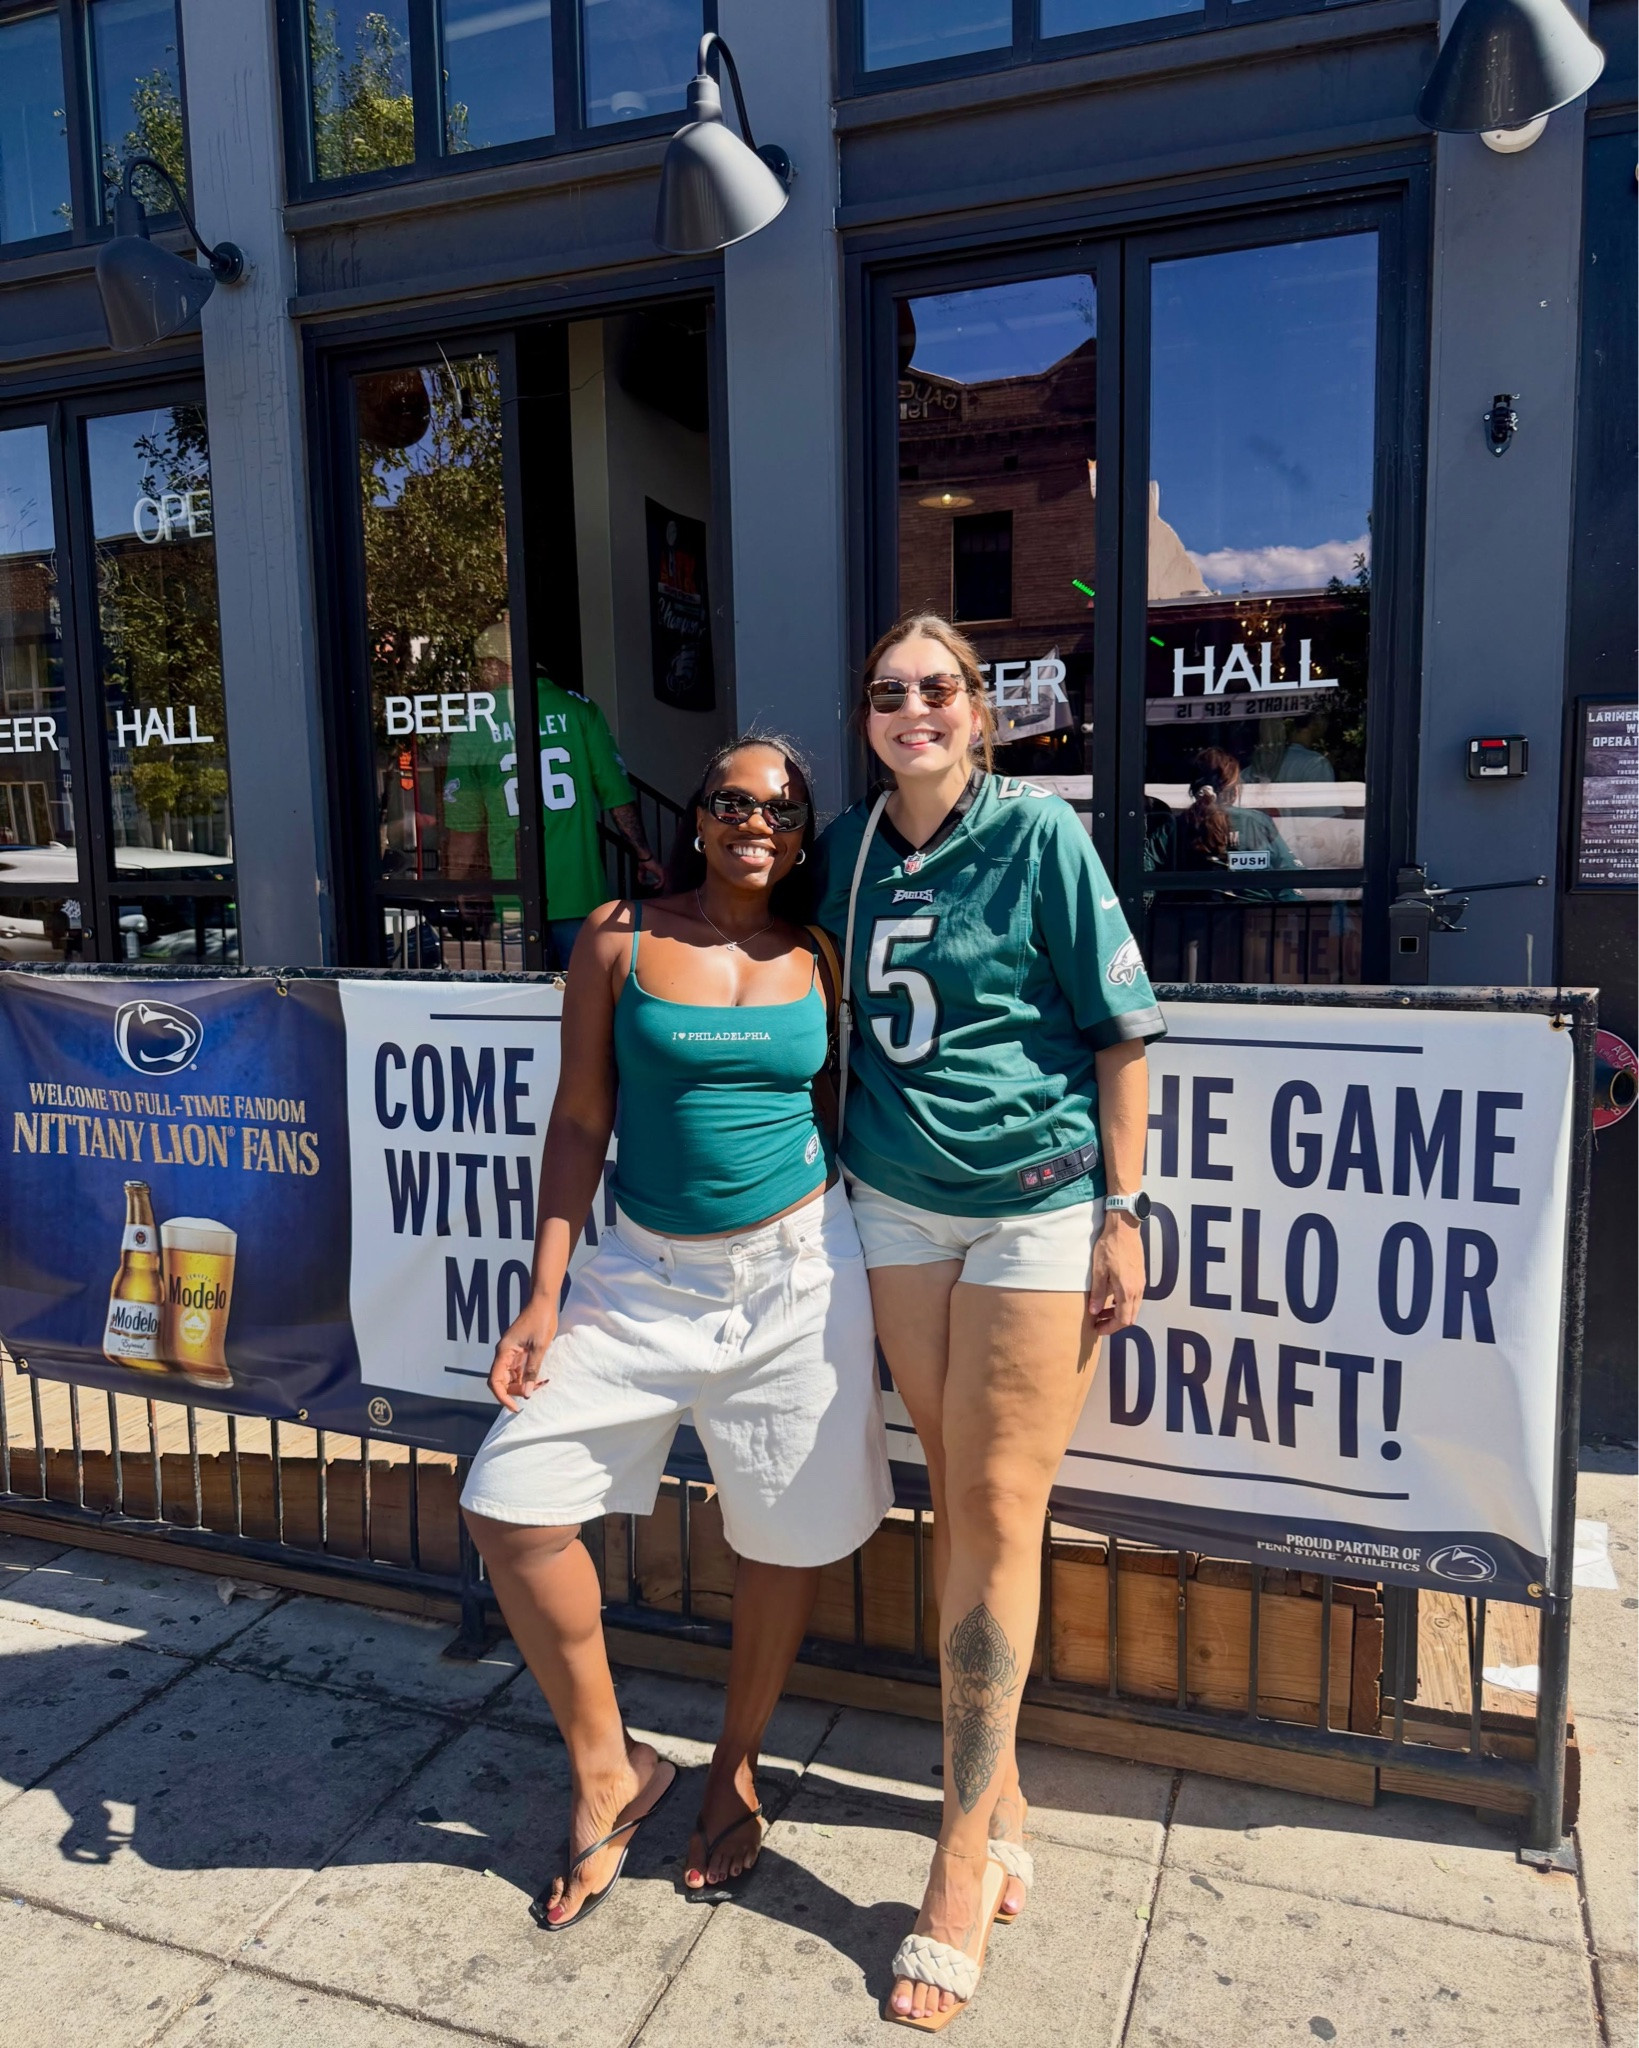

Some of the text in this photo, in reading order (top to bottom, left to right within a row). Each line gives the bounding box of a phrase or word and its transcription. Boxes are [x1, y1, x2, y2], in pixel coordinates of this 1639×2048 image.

[133, 490, 213, 544] OPE
[976, 659, 1069, 707] EER
[1171, 638, 1339, 698] HALL
[116, 705, 214, 748] HALL
[385, 692, 499, 735] BEER
[1588, 711, 1638, 722] LARIMER
[1231, 857, 1266, 866] PUSH
[891, 888, 935, 904] EAGLES
[867, 916, 940, 1065] 5
[672, 1031, 772, 1041] I PHILADELPHIA
[28, 1082, 306, 1124] WELCOME TO FULL-TIME FANDOM
[374, 1041, 537, 1136] COME
[12, 1111, 145, 1163] NITTANY
[242, 1126, 320, 1176] FANS
[1142, 1074, 1524, 1206] HE GAME
[384, 1148, 535, 1241] WITH
[169, 1273, 227, 1310] Modelo
[1140, 1202, 1499, 1345] DELO OR
[115, 1306, 158, 1333] Modelo
[445, 1256, 540, 1344] MO
[1108, 1325, 1403, 1462] DRAFT!
[1257, 1541, 1292, 1554] PENN
[1344, 1555, 1421, 1572] ATHLETICS
[1286, 1534, 1421, 1561] PROUD PARTNER OF
